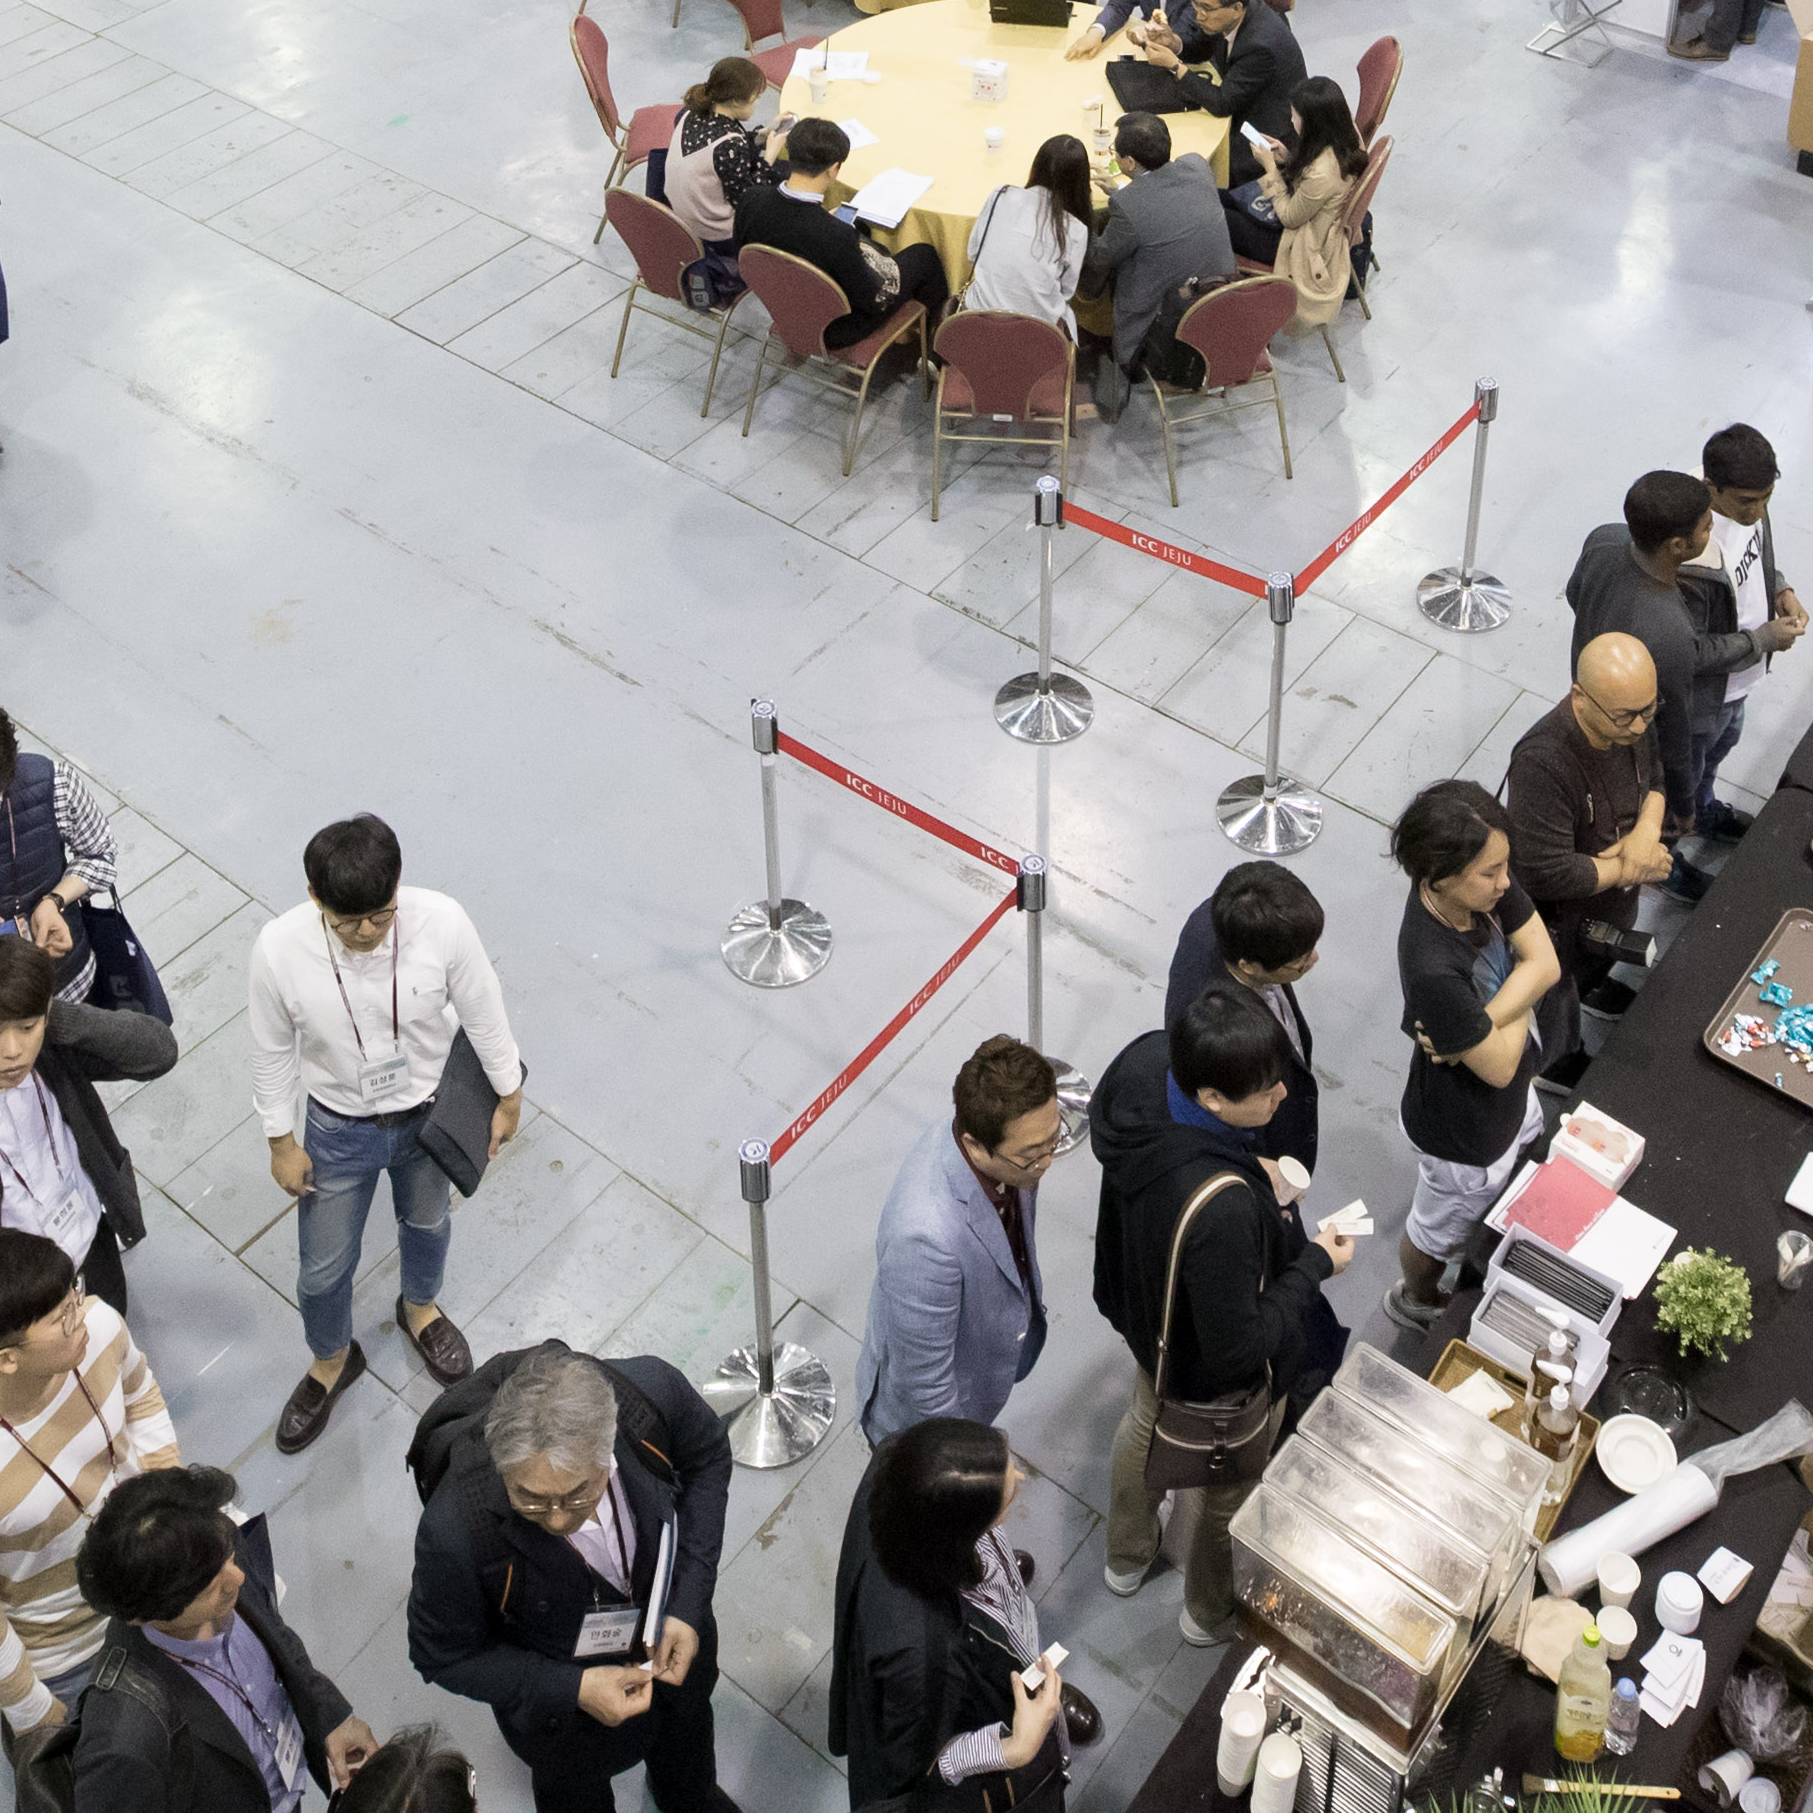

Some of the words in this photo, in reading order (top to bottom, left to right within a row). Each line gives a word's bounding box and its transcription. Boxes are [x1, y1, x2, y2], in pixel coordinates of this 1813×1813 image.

[1409, 461, 1427, 482] ICC
[1425, 438, 1445, 465] JEJU
[1131, 533, 1159, 554] ICC
[1162, 545, 1192, 567] JEJU
[1334, 530, 1353, 554] ICC
[1353, 511, 1373, 536] JEJU
[845, 773, 873, 798] ICC
[877, 791, 907, 816] JEJU
[980, 845, 1010, 871] ICC
[908, 982, 934, 1016] ICC
[933, 952, 962, 987] JEJU
[790, 1105, 817, 1141] ICC
[819, 1073, 848, 1110] JEJU
